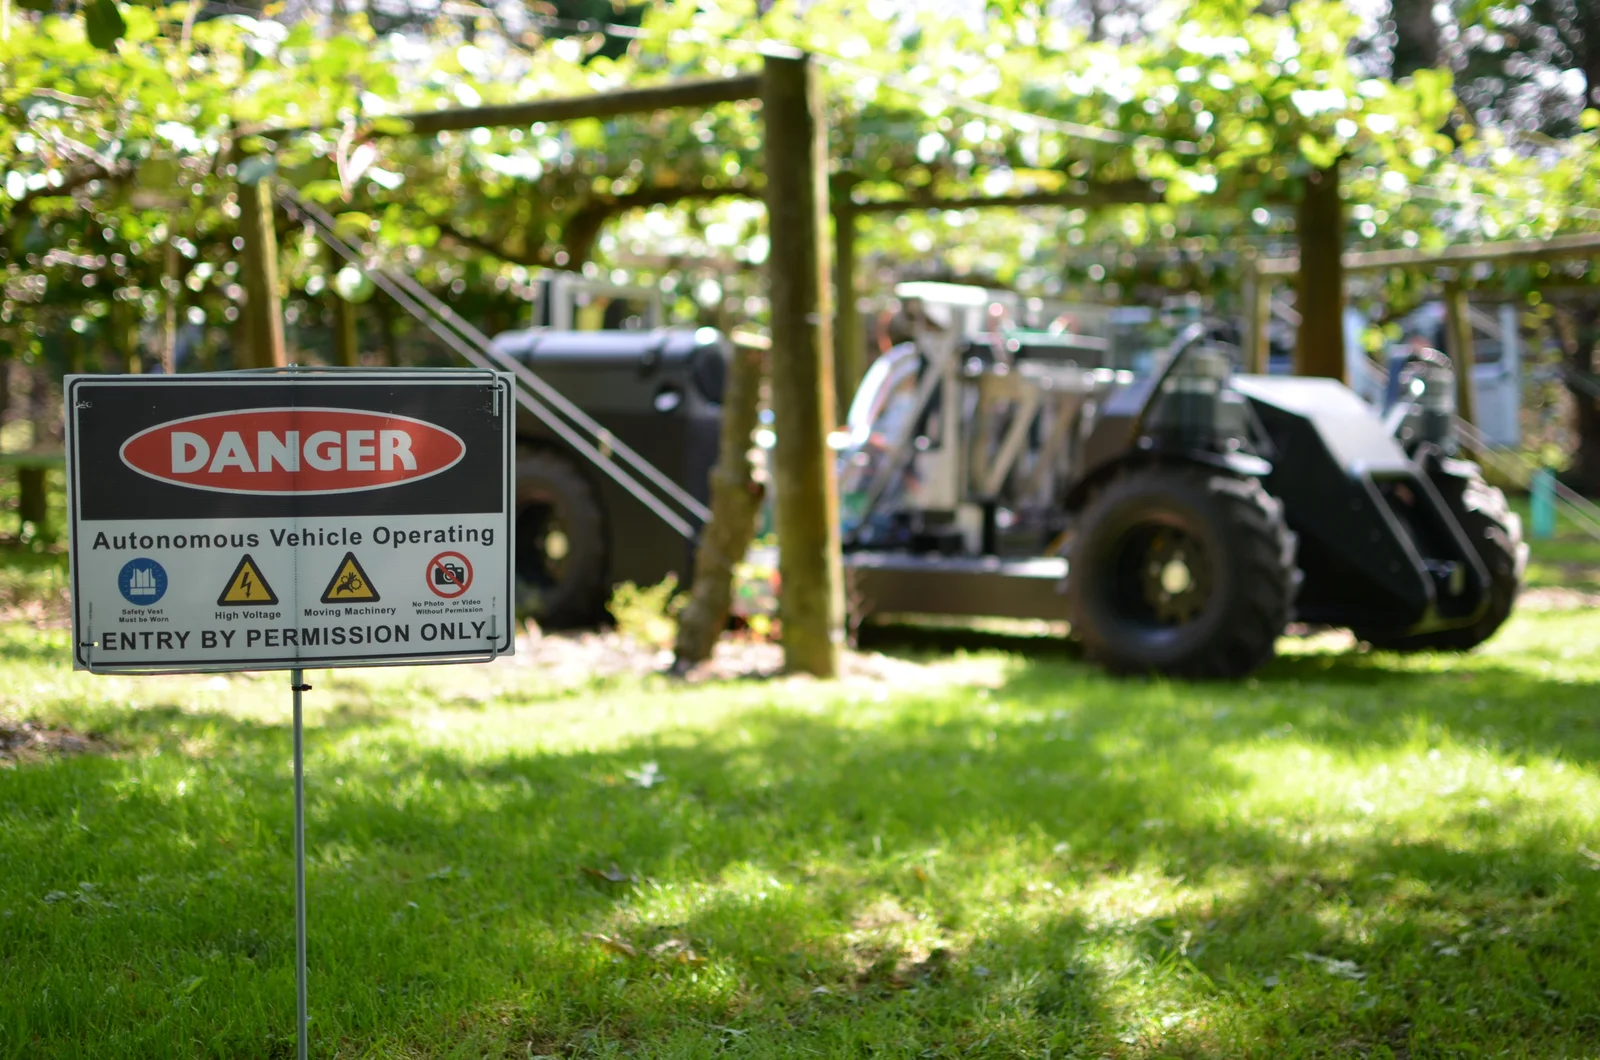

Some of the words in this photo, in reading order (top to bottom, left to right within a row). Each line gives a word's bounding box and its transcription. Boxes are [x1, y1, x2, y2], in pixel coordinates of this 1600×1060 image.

[170, 429, 418, 474] DANGER
[93, 531, 260, 550] Autonomous
[269, 527, 362, 546] Vehicle
[373, 525, 494, 549] Operating
[121, 608, 145, 616] Safety
[215, 611, 239, 620] High
[243, 610, 281, 620] Voltage
[304, 608, 341, 617] Moving
[344, 606, 397, 616] Machinery
[102, 631, 191, 651] ENTRY
[201, 630, 236, 649] BY
[247, 625, 410, 648] PERMISSION
[420, 621, 486, 641] ONLY
